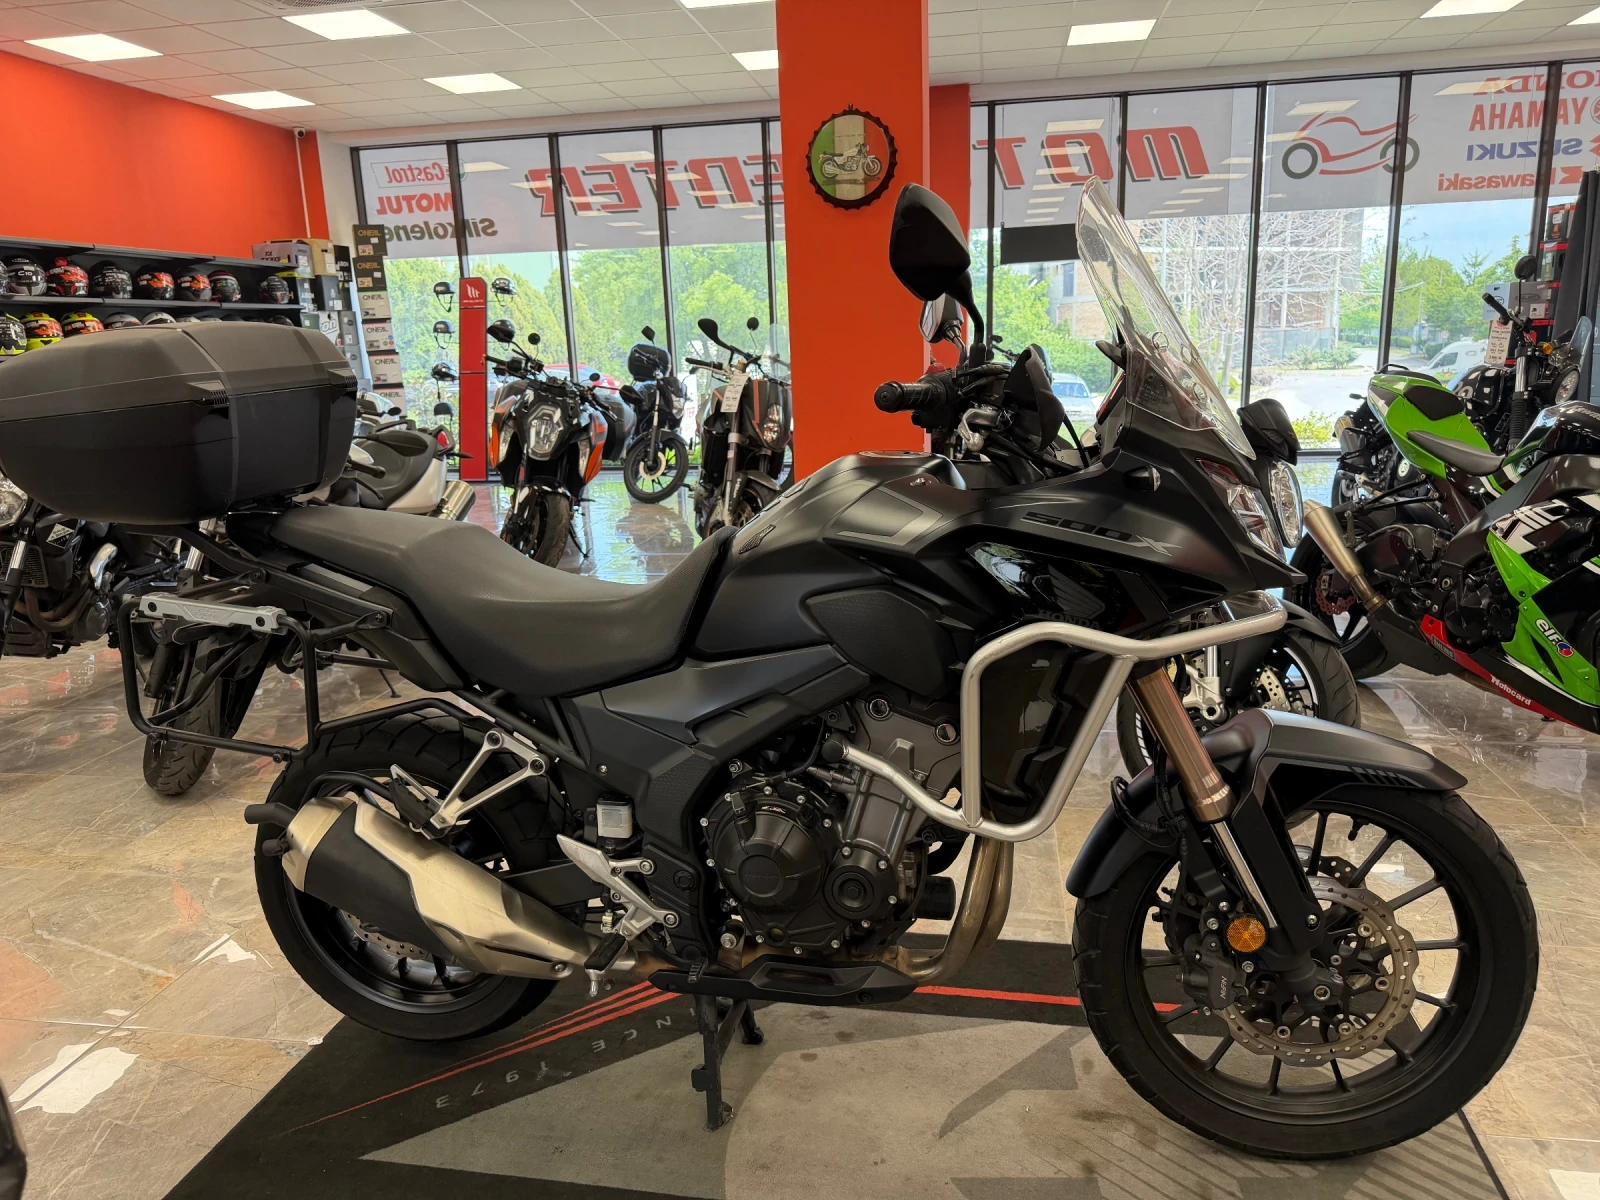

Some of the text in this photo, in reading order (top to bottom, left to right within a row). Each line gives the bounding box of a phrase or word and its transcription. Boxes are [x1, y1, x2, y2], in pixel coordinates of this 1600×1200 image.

[1037, 608, 1100, 630] HONDA
[1490, 673, 1531, 706] Motocard
[591, 1006, 697, 1053] INCE
